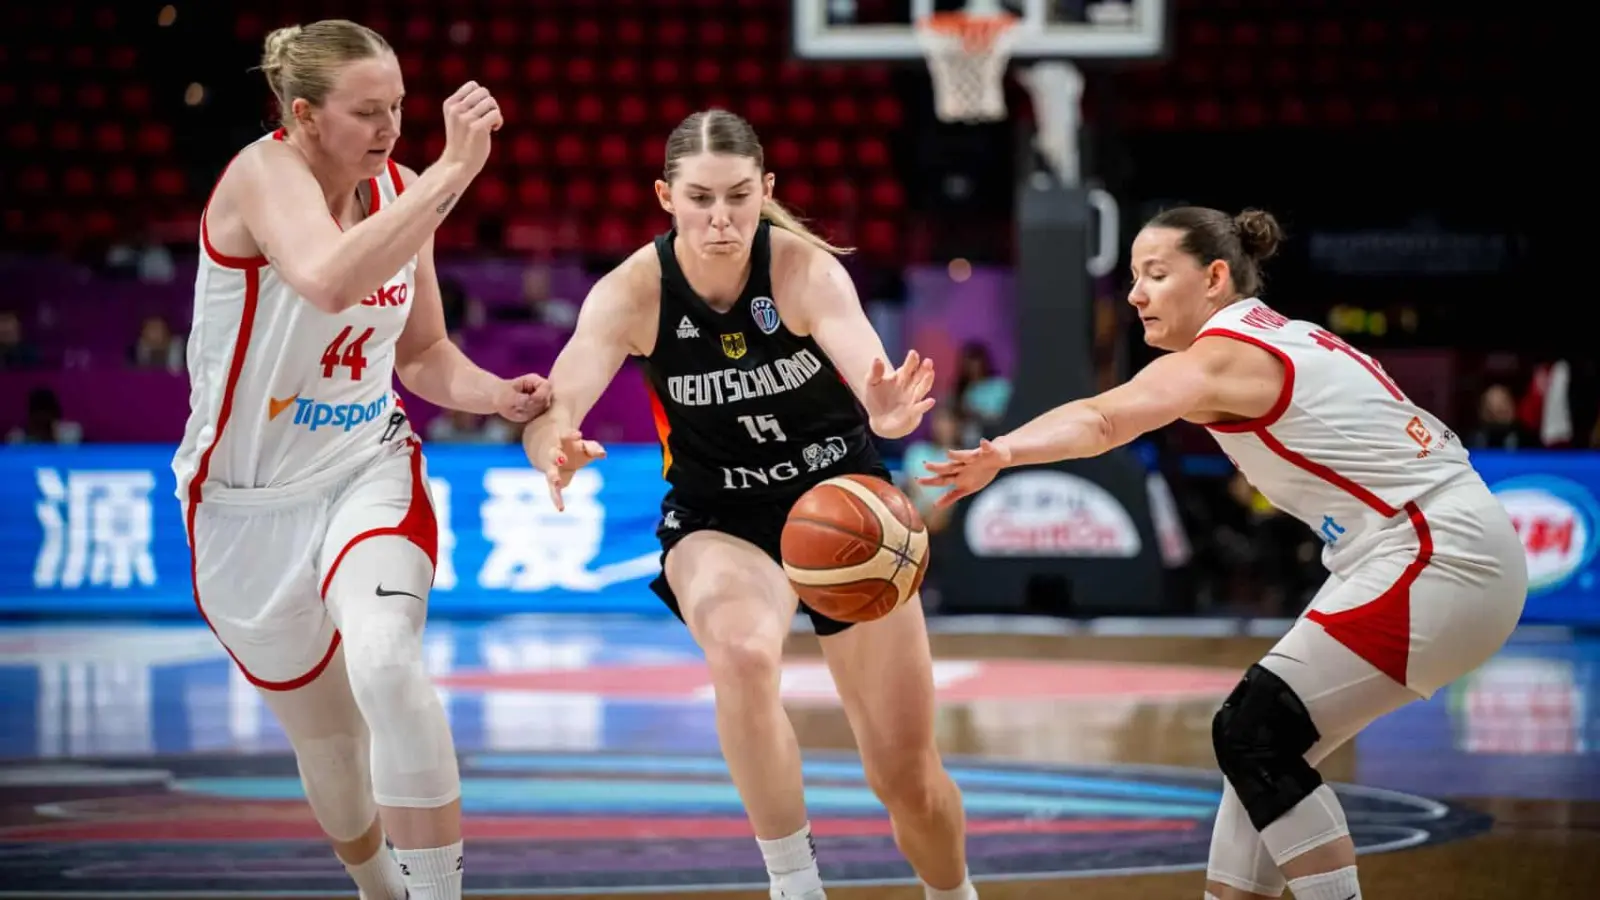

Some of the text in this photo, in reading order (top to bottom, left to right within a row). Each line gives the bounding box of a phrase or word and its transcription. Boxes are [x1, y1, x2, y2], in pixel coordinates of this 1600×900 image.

[360, 283, 408, 307] SKO
[320, 325, 375, 381] 44
[668, 348, 822, 406] DEUTSCHLAND
[737, 413, 787, 444] 15
[721, 461, 799, 489] ING
